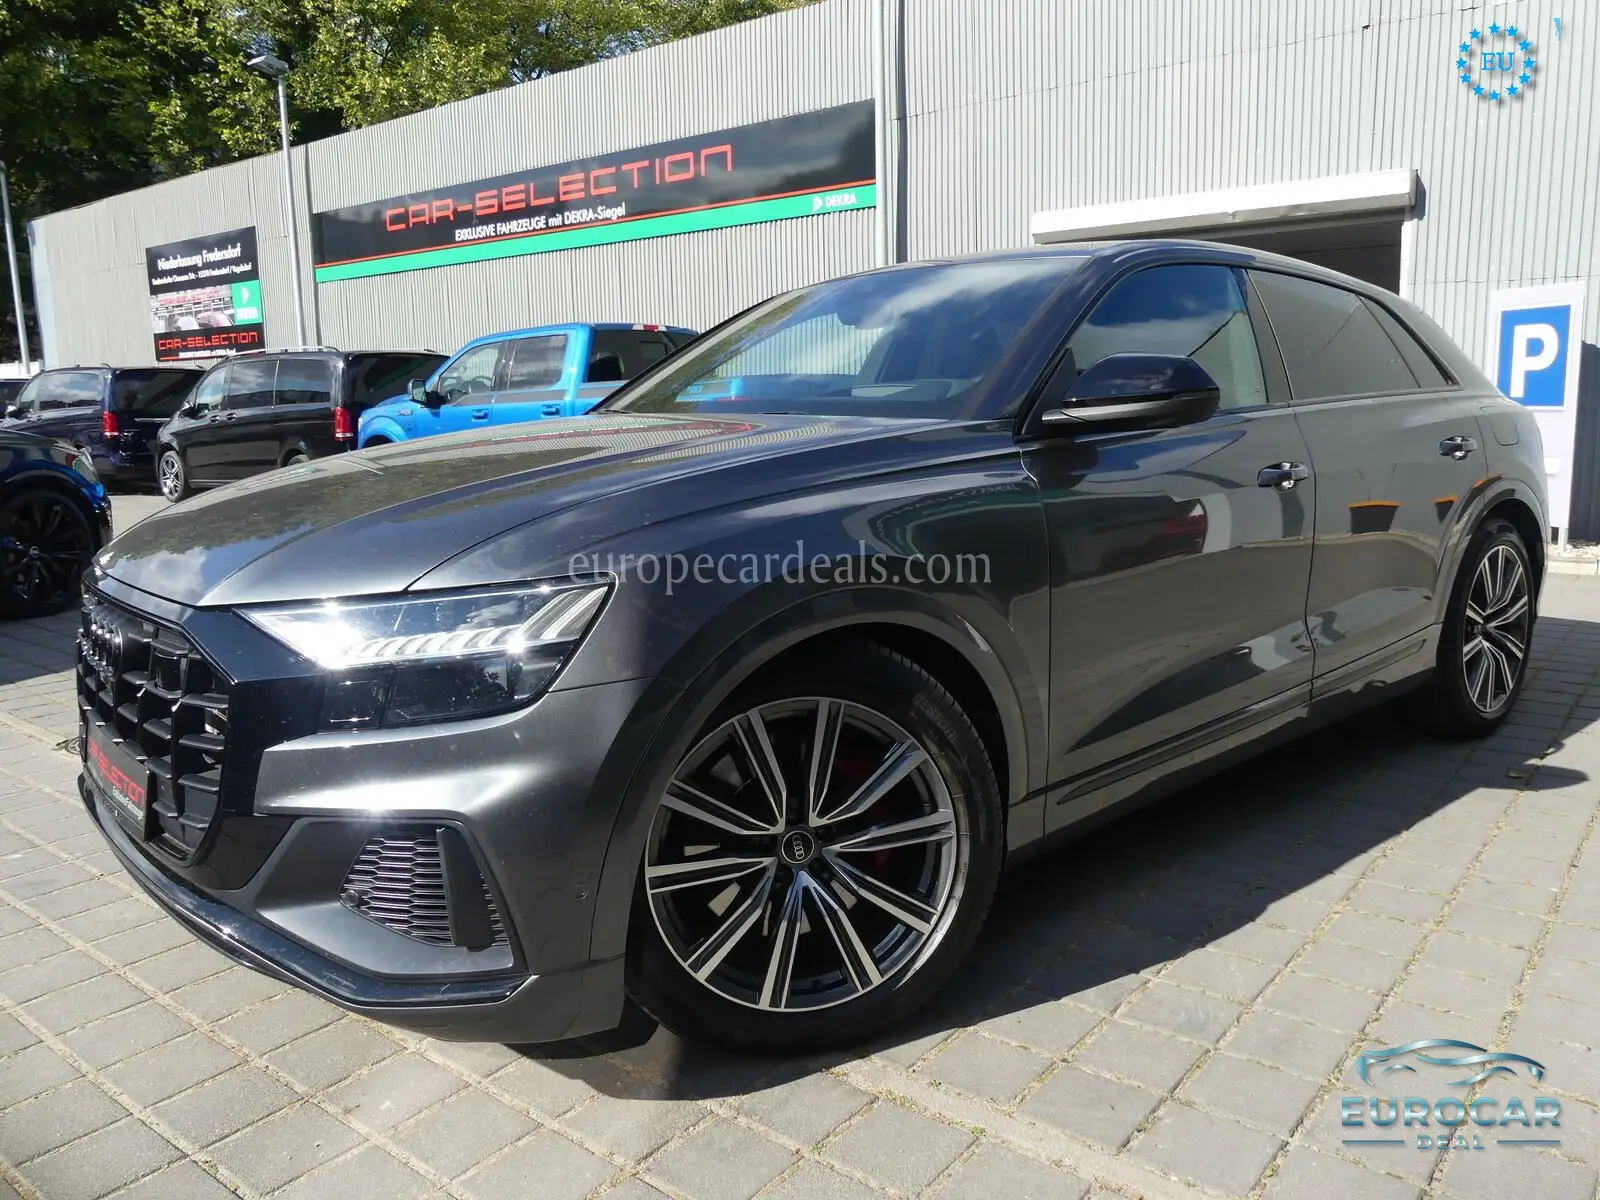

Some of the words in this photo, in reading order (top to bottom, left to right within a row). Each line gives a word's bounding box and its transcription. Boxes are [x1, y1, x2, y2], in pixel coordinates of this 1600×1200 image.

[385, 143, 733, 232] CAR-SELECTION
[455, 224, 496, 241] EXKLUSIVE
[496, 216, 546, 235] FAHRZEUGE
[548, 214, 563, 227] mit
[564, 201, 626, 225] DEKRA-Siegel
[158, 331, 259, 350] CAR-SELECTION
[1510, 323, 1559, 398] P
